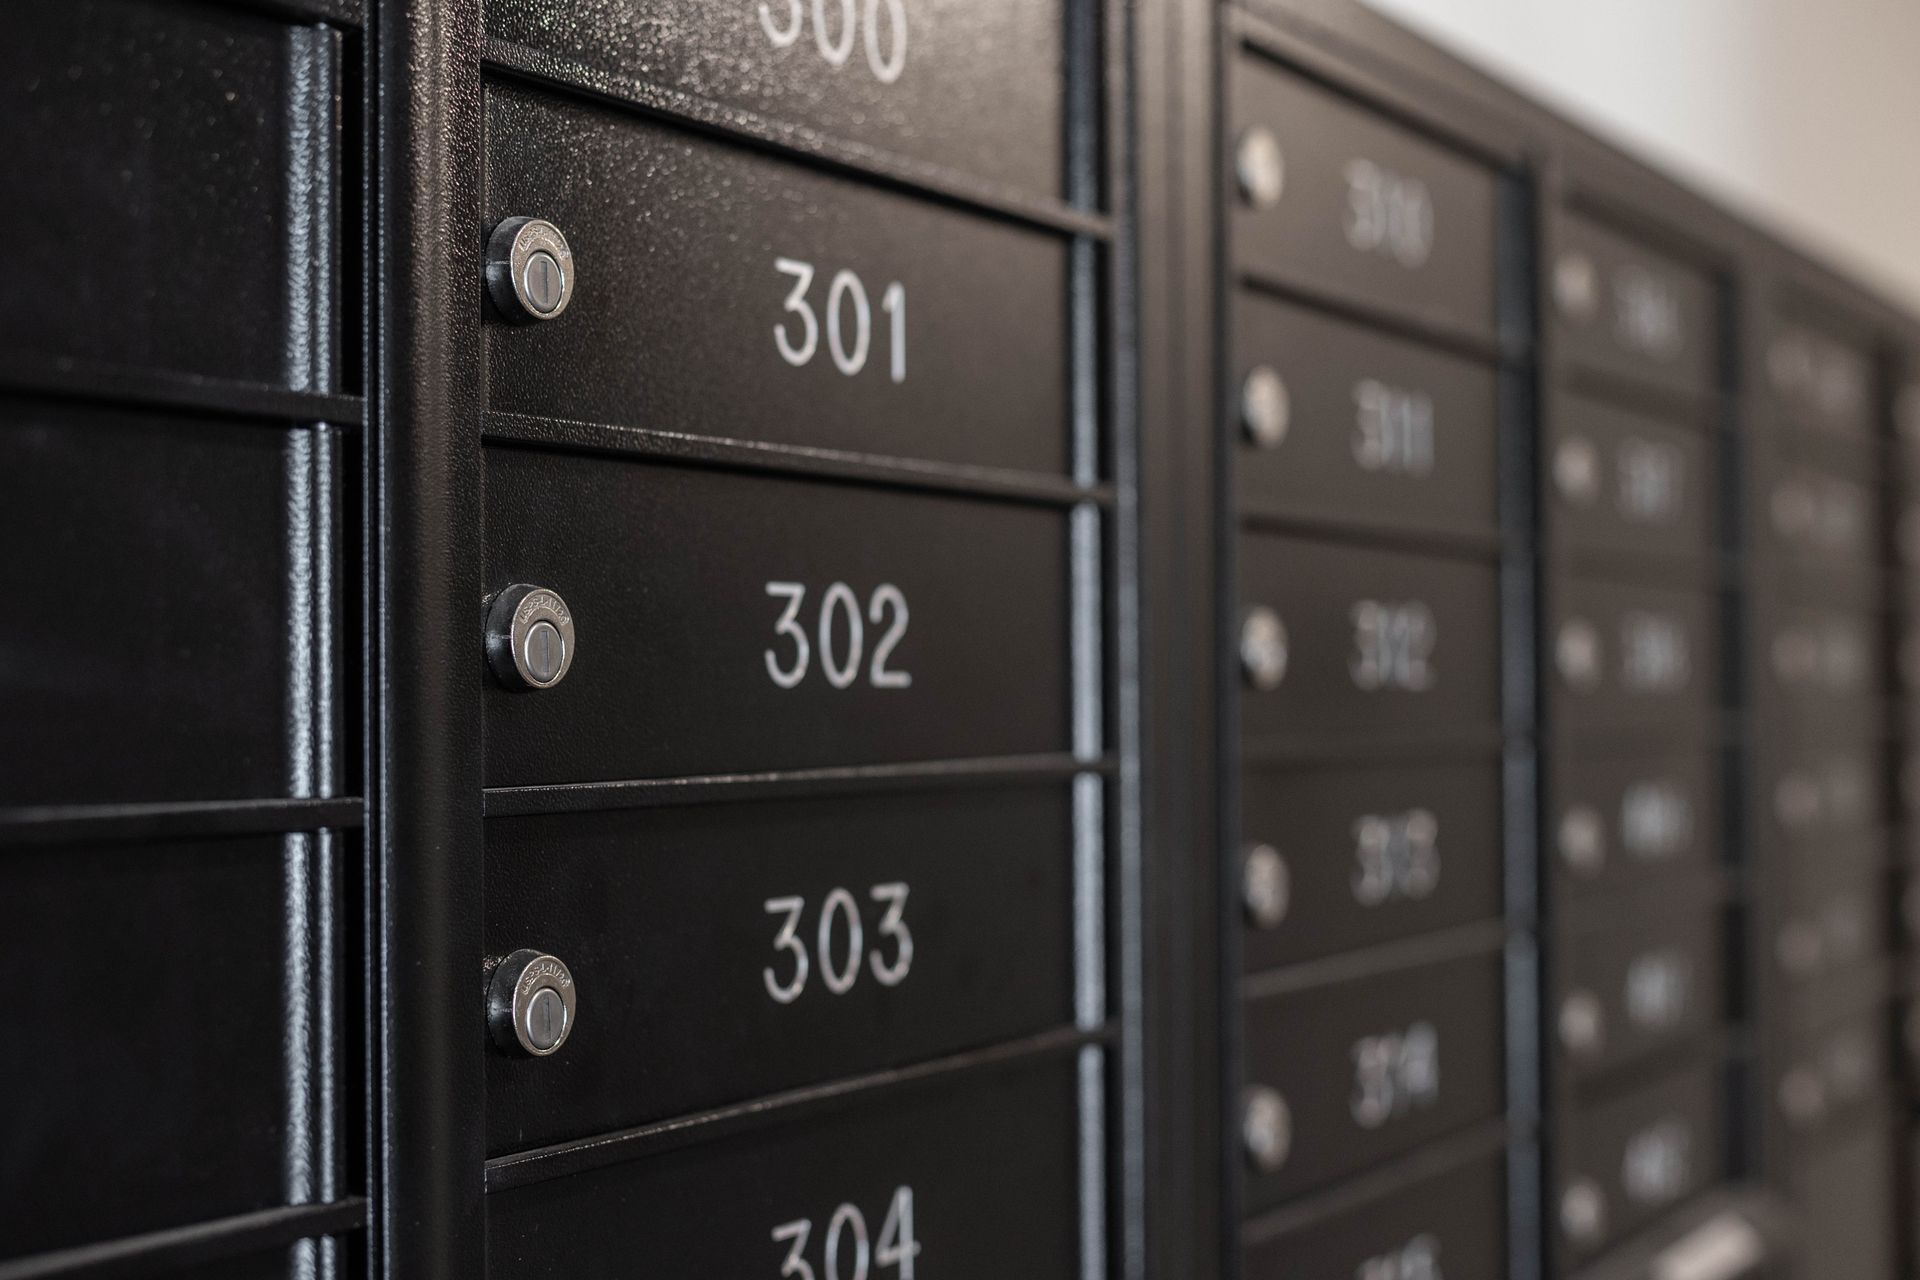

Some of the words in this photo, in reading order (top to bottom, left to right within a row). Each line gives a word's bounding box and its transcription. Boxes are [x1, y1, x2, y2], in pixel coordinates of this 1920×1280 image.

[774, 257, 907, 383] 301
[764, 581, 912, 689] 302
[763, 881, 914, 1004] 303
[772, 1185, 921, 1280] 304
